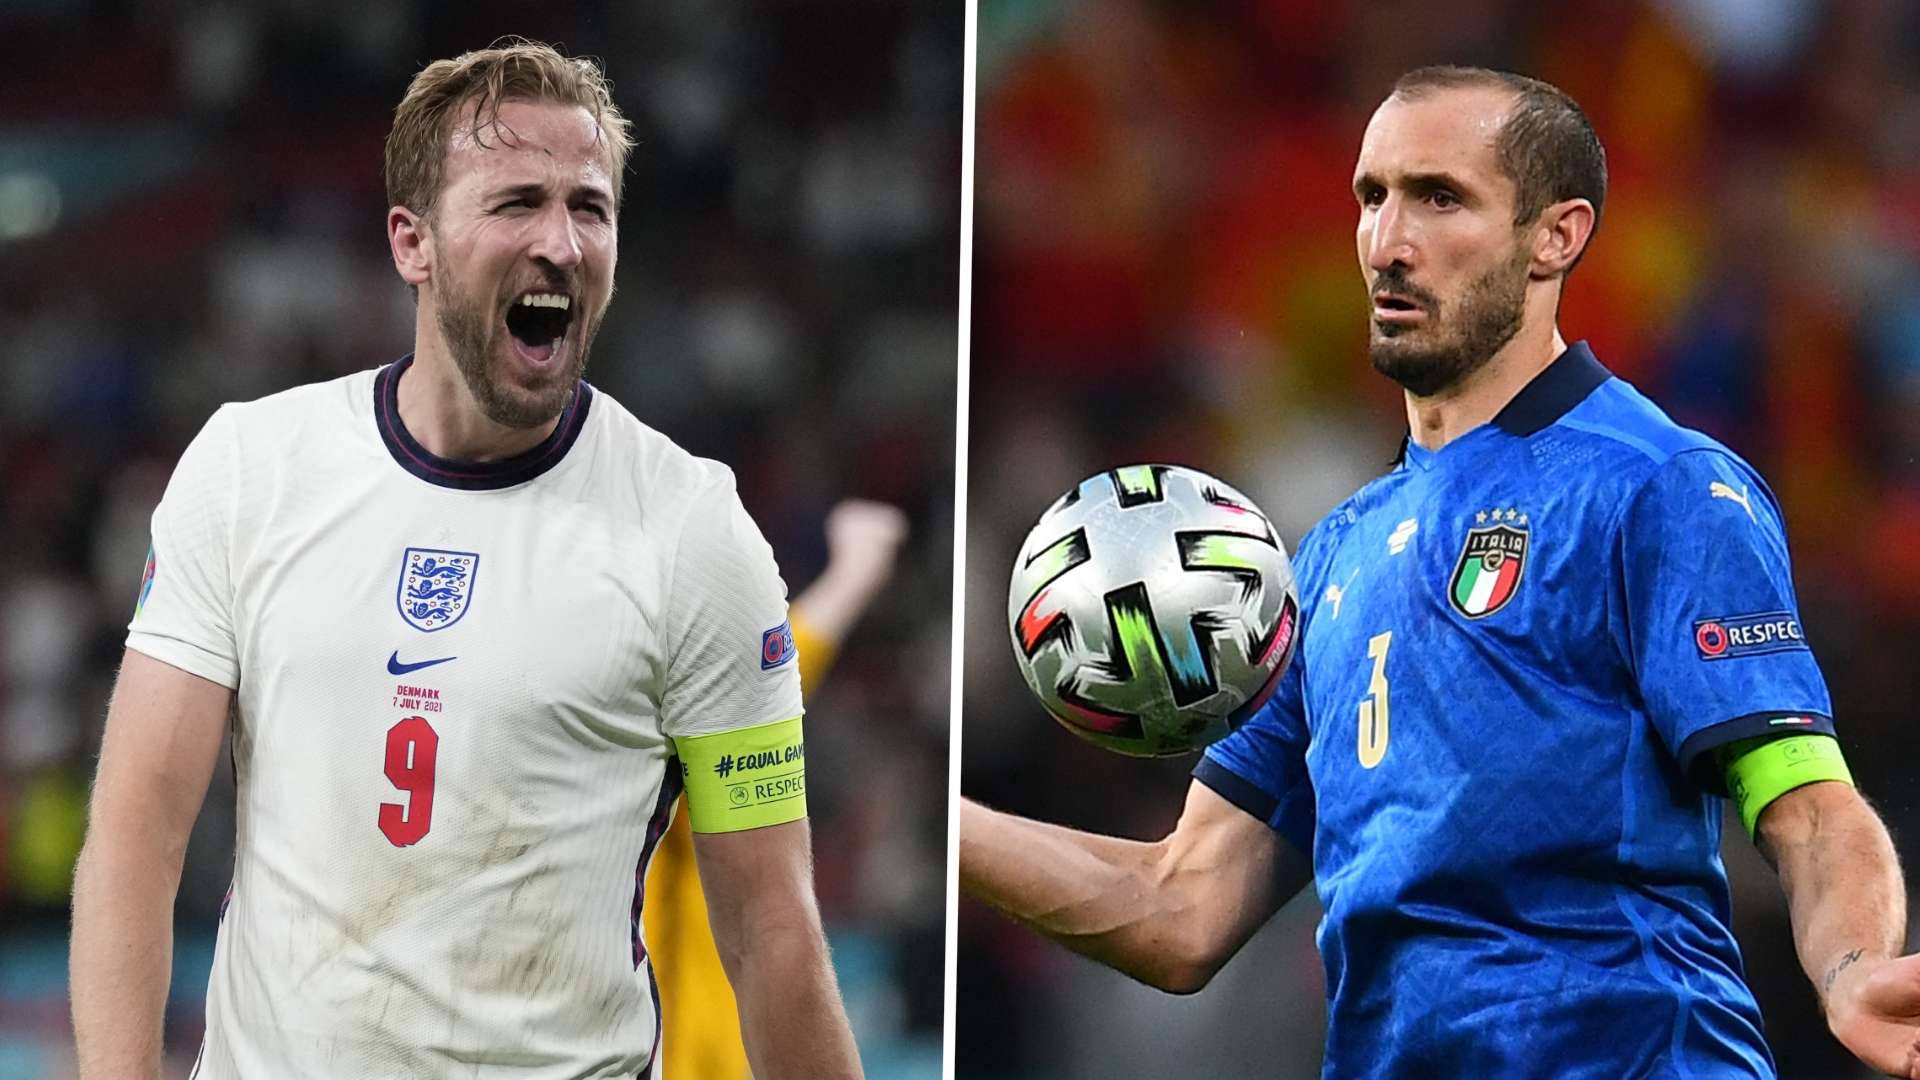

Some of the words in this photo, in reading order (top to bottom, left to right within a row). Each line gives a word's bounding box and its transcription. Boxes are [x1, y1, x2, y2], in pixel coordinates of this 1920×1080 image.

[1471, 534, 1523, 551] ITALIA
[397, 685, 439, 699] DENMARK
[1358, 631, 1393, 769] 3
[392, 696, 398, 707] 7
[399, 698, 421, 710] JULY
[424, 700, 442, 712] 2021
[378, 715, 439, 848] 9
